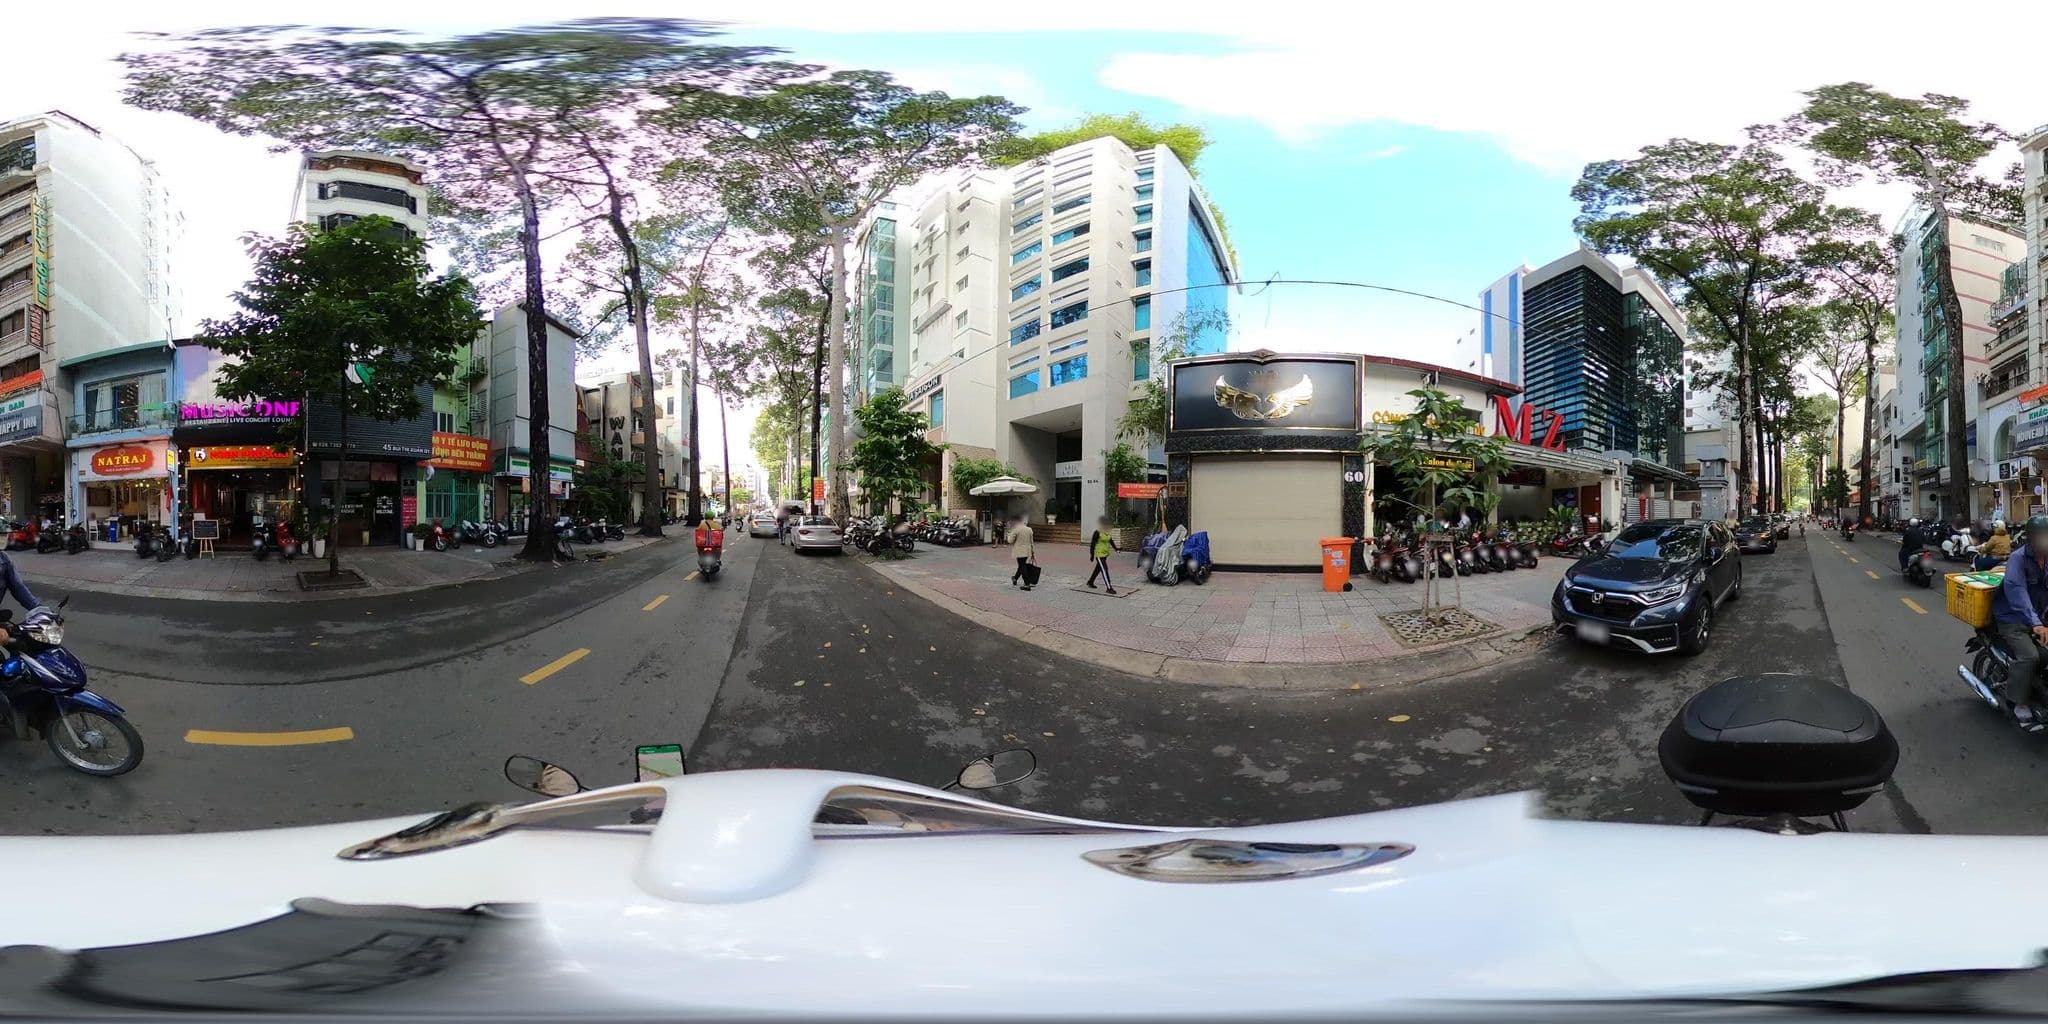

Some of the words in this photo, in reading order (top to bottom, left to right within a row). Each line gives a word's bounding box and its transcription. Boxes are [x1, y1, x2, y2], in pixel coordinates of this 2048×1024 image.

[182, 401, 252, 419] MUSIC
[98, 454, 147, 467] NATRAJ
[1344, 471, 1364, 483] 60
